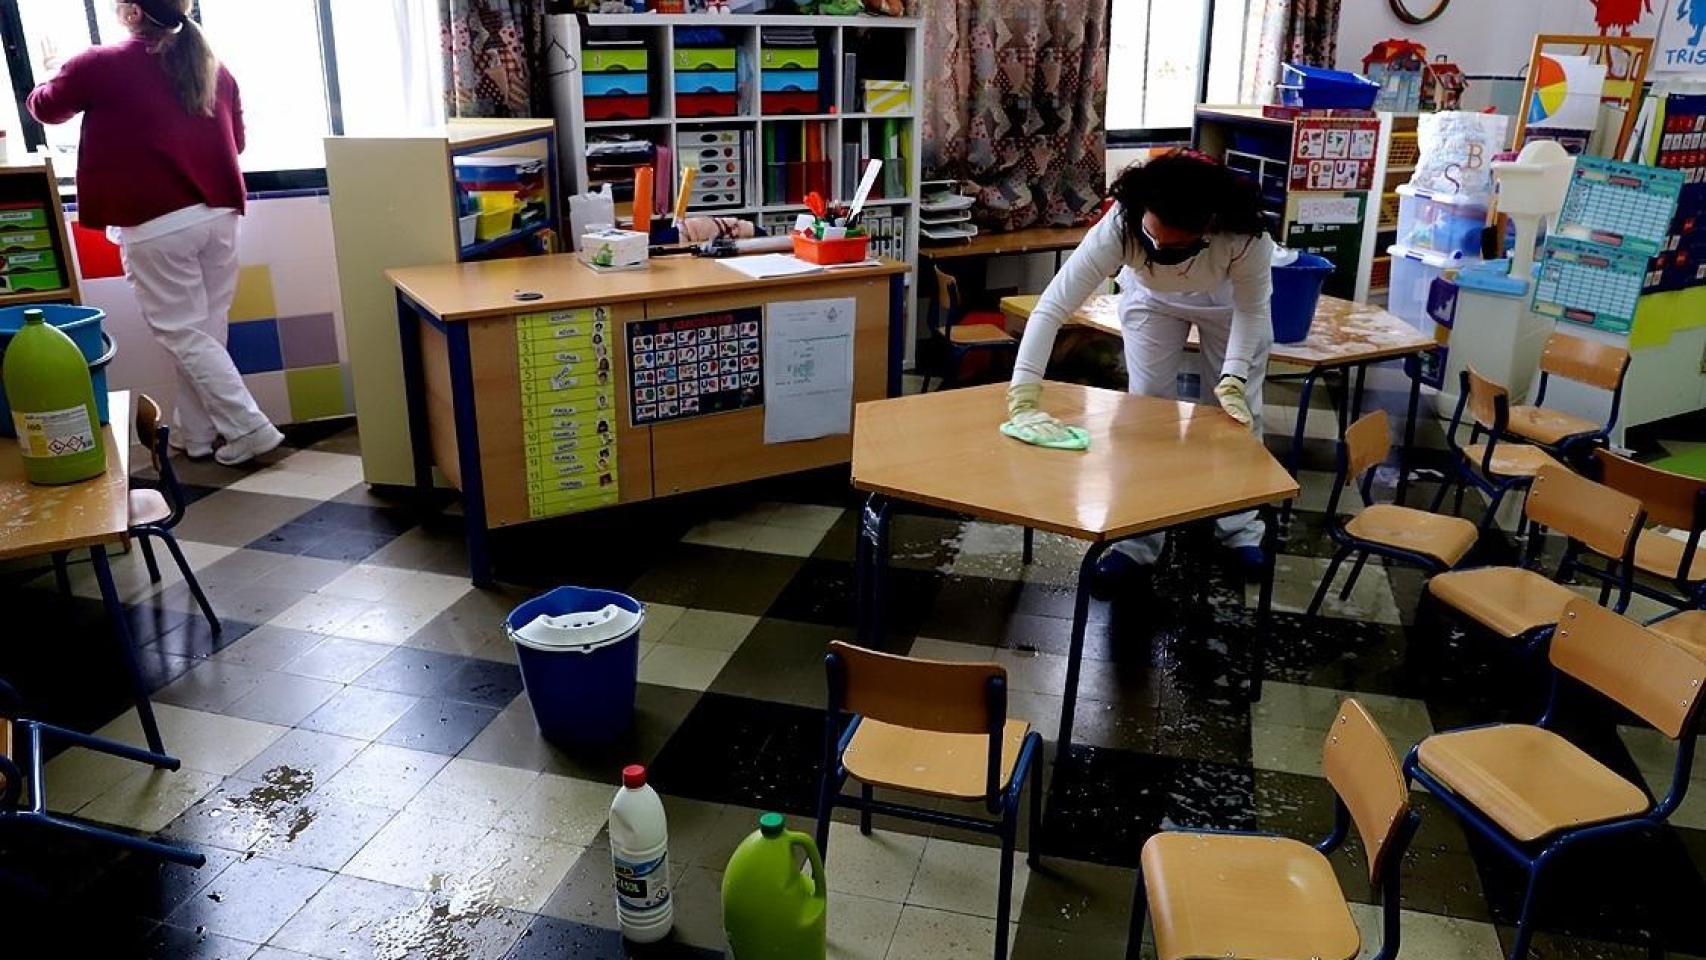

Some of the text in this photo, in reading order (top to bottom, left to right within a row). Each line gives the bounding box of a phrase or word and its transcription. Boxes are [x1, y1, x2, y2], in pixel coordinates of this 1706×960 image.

[1301, 131, 1310, 142] A
[1327, 131, 1333, 144] E
[1467, 143, 1484, 169] B
[1311, 162, 1346, 174] O U
[1444, 163, 1461, 194] S
